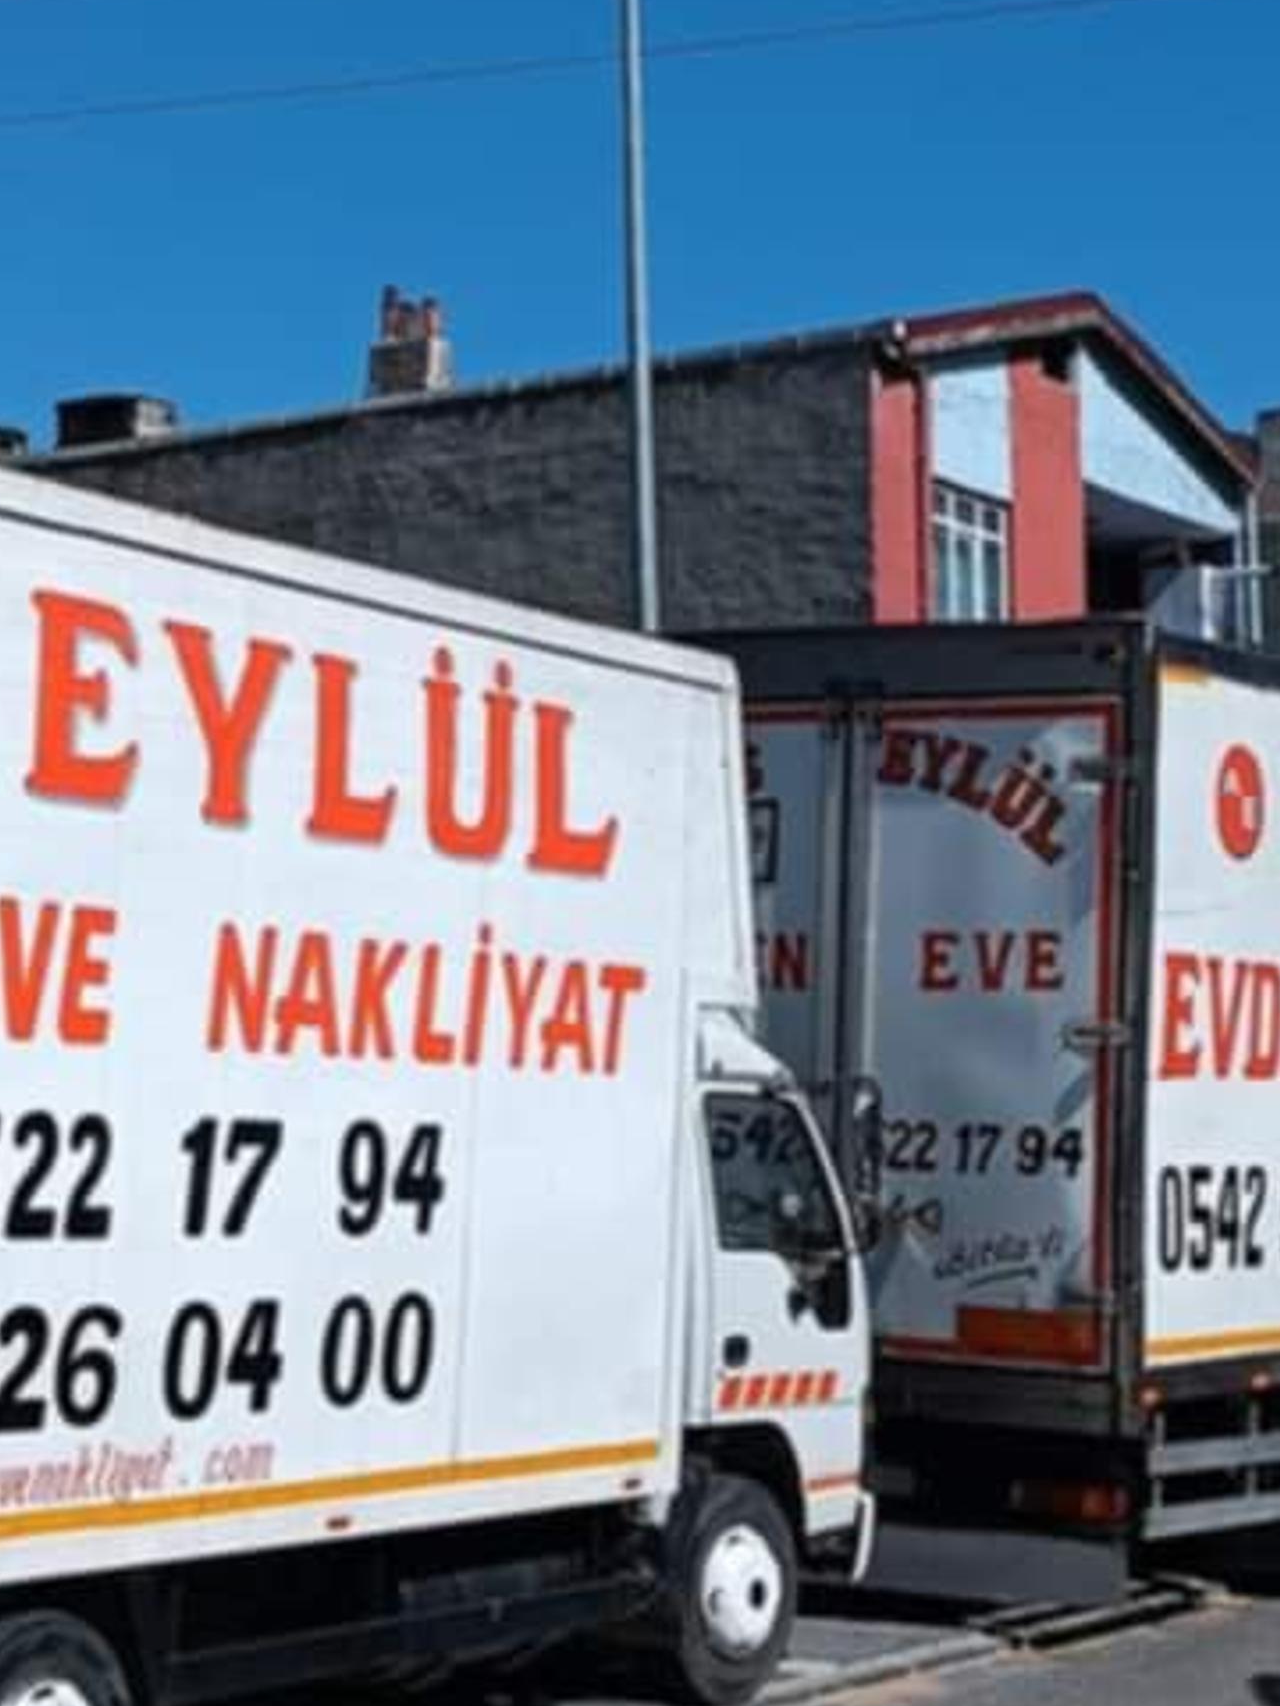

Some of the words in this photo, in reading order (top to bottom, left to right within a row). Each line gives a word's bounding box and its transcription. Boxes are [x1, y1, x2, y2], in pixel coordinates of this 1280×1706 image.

[23, 587, 618, 881] EYLÜL
[877, 729, 1066, 867] EYLÜL
[206, 923, 646, 1077] NAKLİYAT
[921, 930, 1065, 991] EVE
[180, 1117, 284, 1239] 17
[338, 1118, 445, 1238] 94
[880, 1118, 939, 1173] 22
[954, 1123, 1003, 1175] 17
[1016, 1124, 1085, 1180] 94
[1157, 1164, 1267, 1274] 0542
[162, 1298, 284, 1421] 04
[319, 1290, 436, 1409] 00
